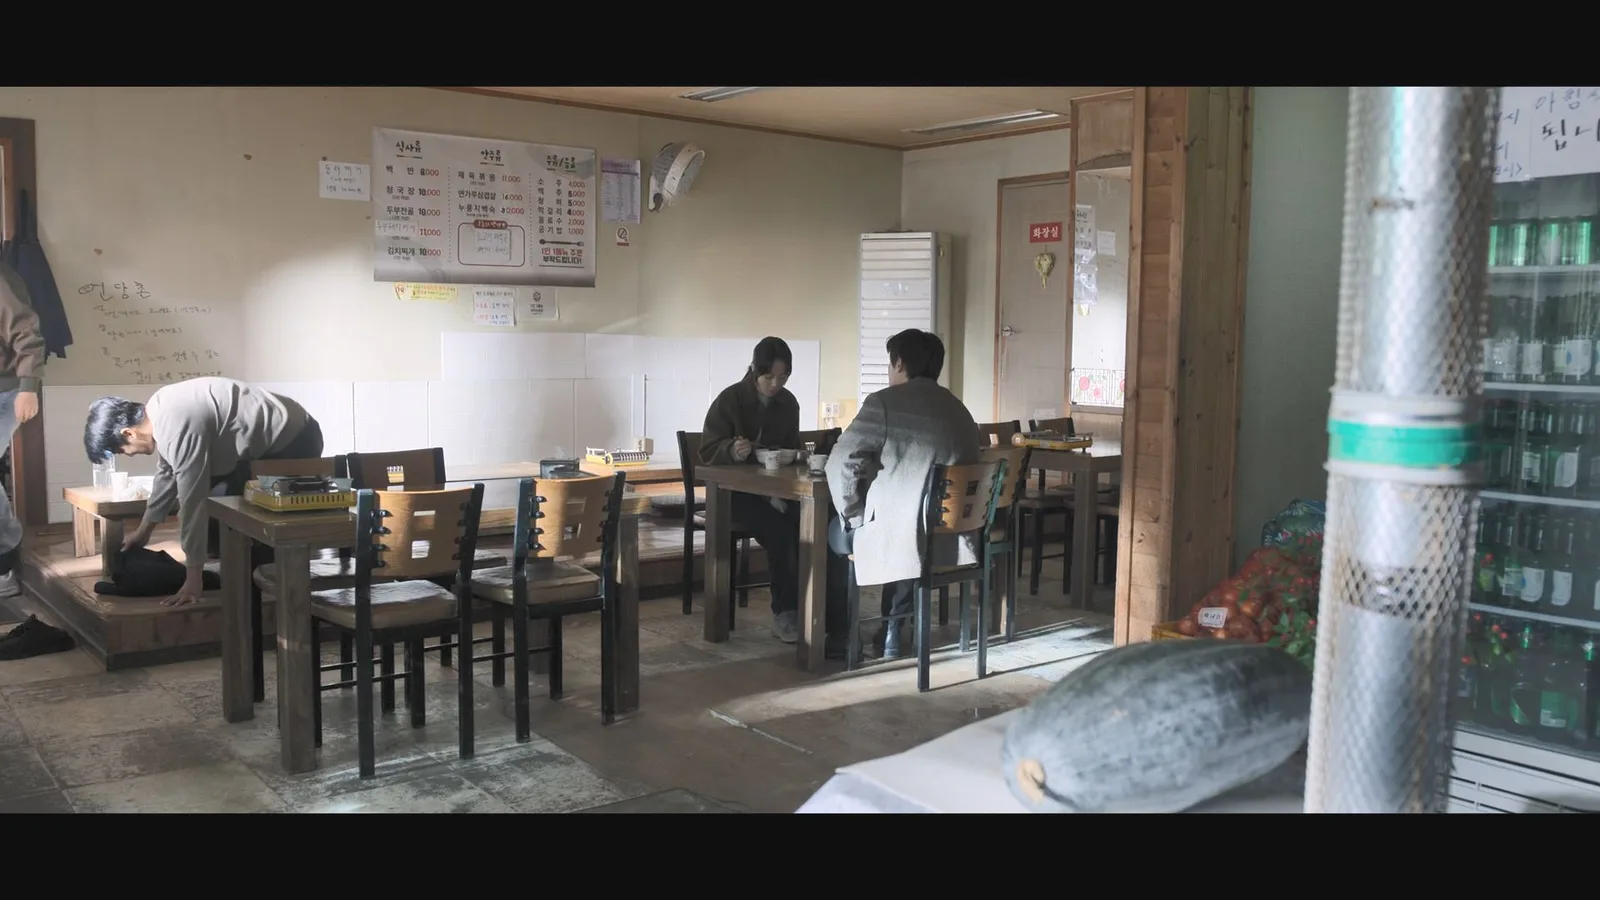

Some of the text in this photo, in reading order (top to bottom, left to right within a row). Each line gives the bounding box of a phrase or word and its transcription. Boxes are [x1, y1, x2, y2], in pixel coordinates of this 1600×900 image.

[396, 140, 421, 153] 식사류
[480, 149, 501, 162] 안주류
[1032, 226, 1059, 239] 화장실
[388, 246, 416, 257] 김치찌개
